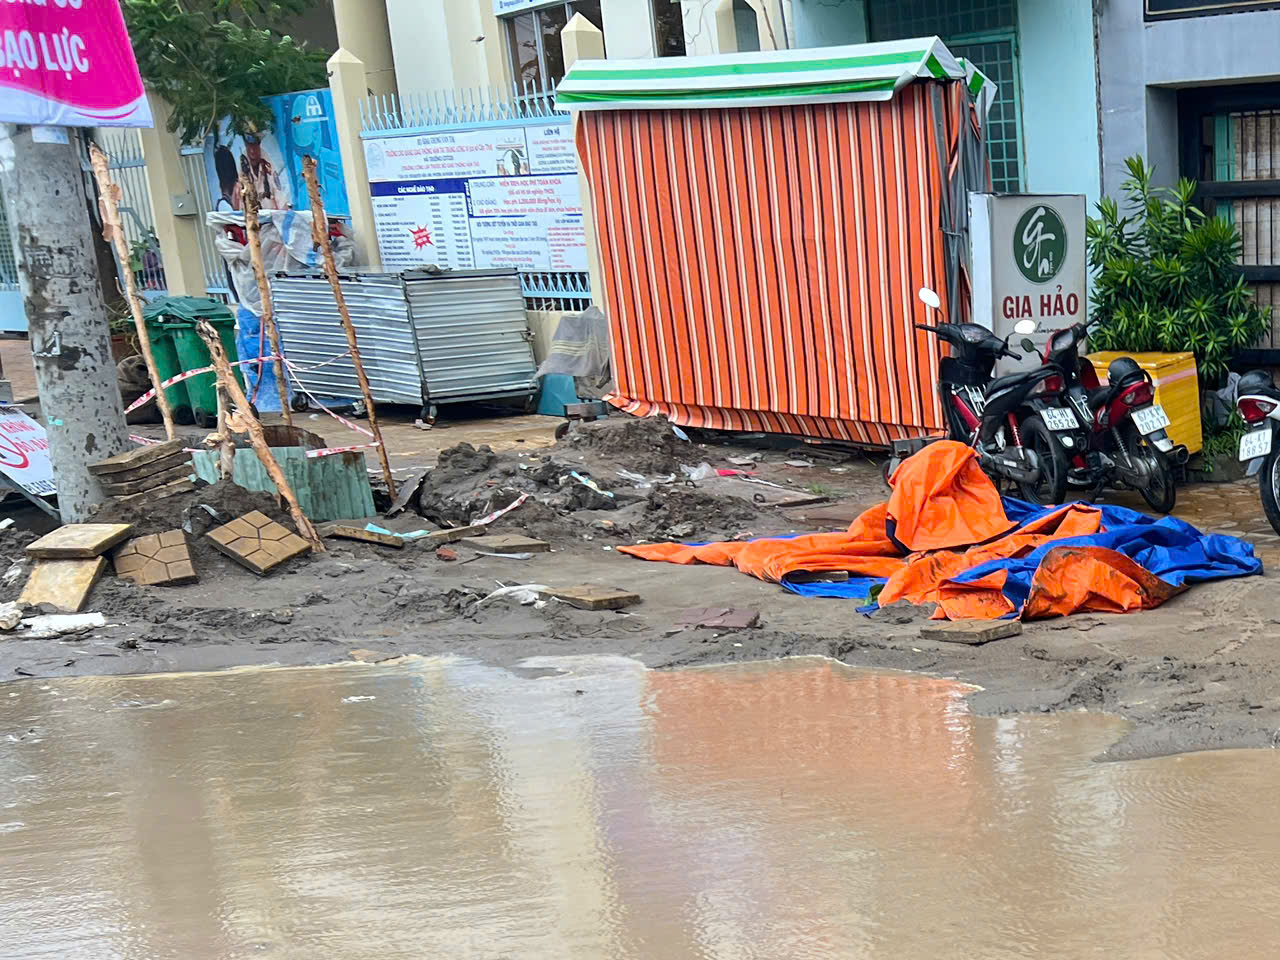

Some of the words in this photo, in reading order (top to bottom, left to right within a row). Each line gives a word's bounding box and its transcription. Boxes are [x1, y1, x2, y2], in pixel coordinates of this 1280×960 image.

[38, 26, 90, 81] LỰC
[1002, 295, 1033, 320] GIA
[1040, 284, 1079, 318] HẢO
